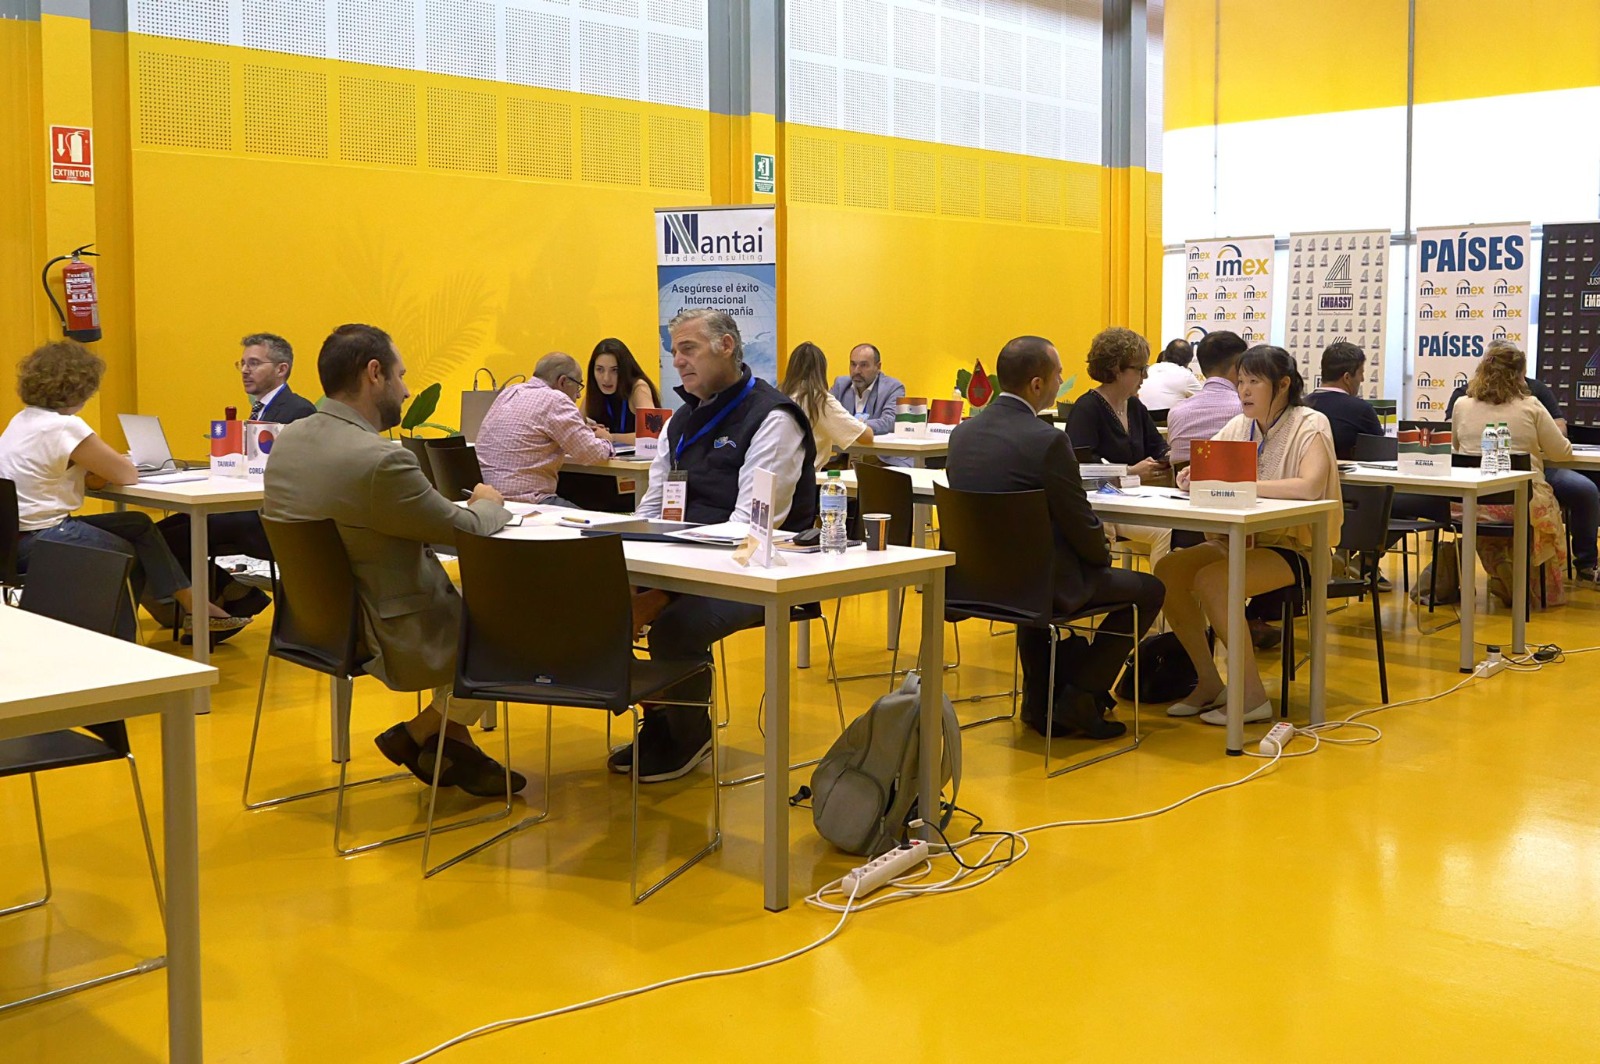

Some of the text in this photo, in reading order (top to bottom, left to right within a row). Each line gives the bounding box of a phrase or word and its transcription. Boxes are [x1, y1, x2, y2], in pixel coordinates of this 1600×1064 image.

[53, 168, 90, 178] EXTINTOR
[664, 213, 763, 254] Nantai
[701, 253, 763, 262] Consulting
[1420, 231, 1524, 273] PAÍSES
[1216, 258, 1269, 277] imex
[671, 283, 759, 295] Asegúrese el éxito
[684, 295, 747, 304] Internacional
[1320, 296, 1352, 308] EMBASSY
[1418, 331, 1484, 357] PAÍSES
[1582, 368, 1597, 377] JUST
